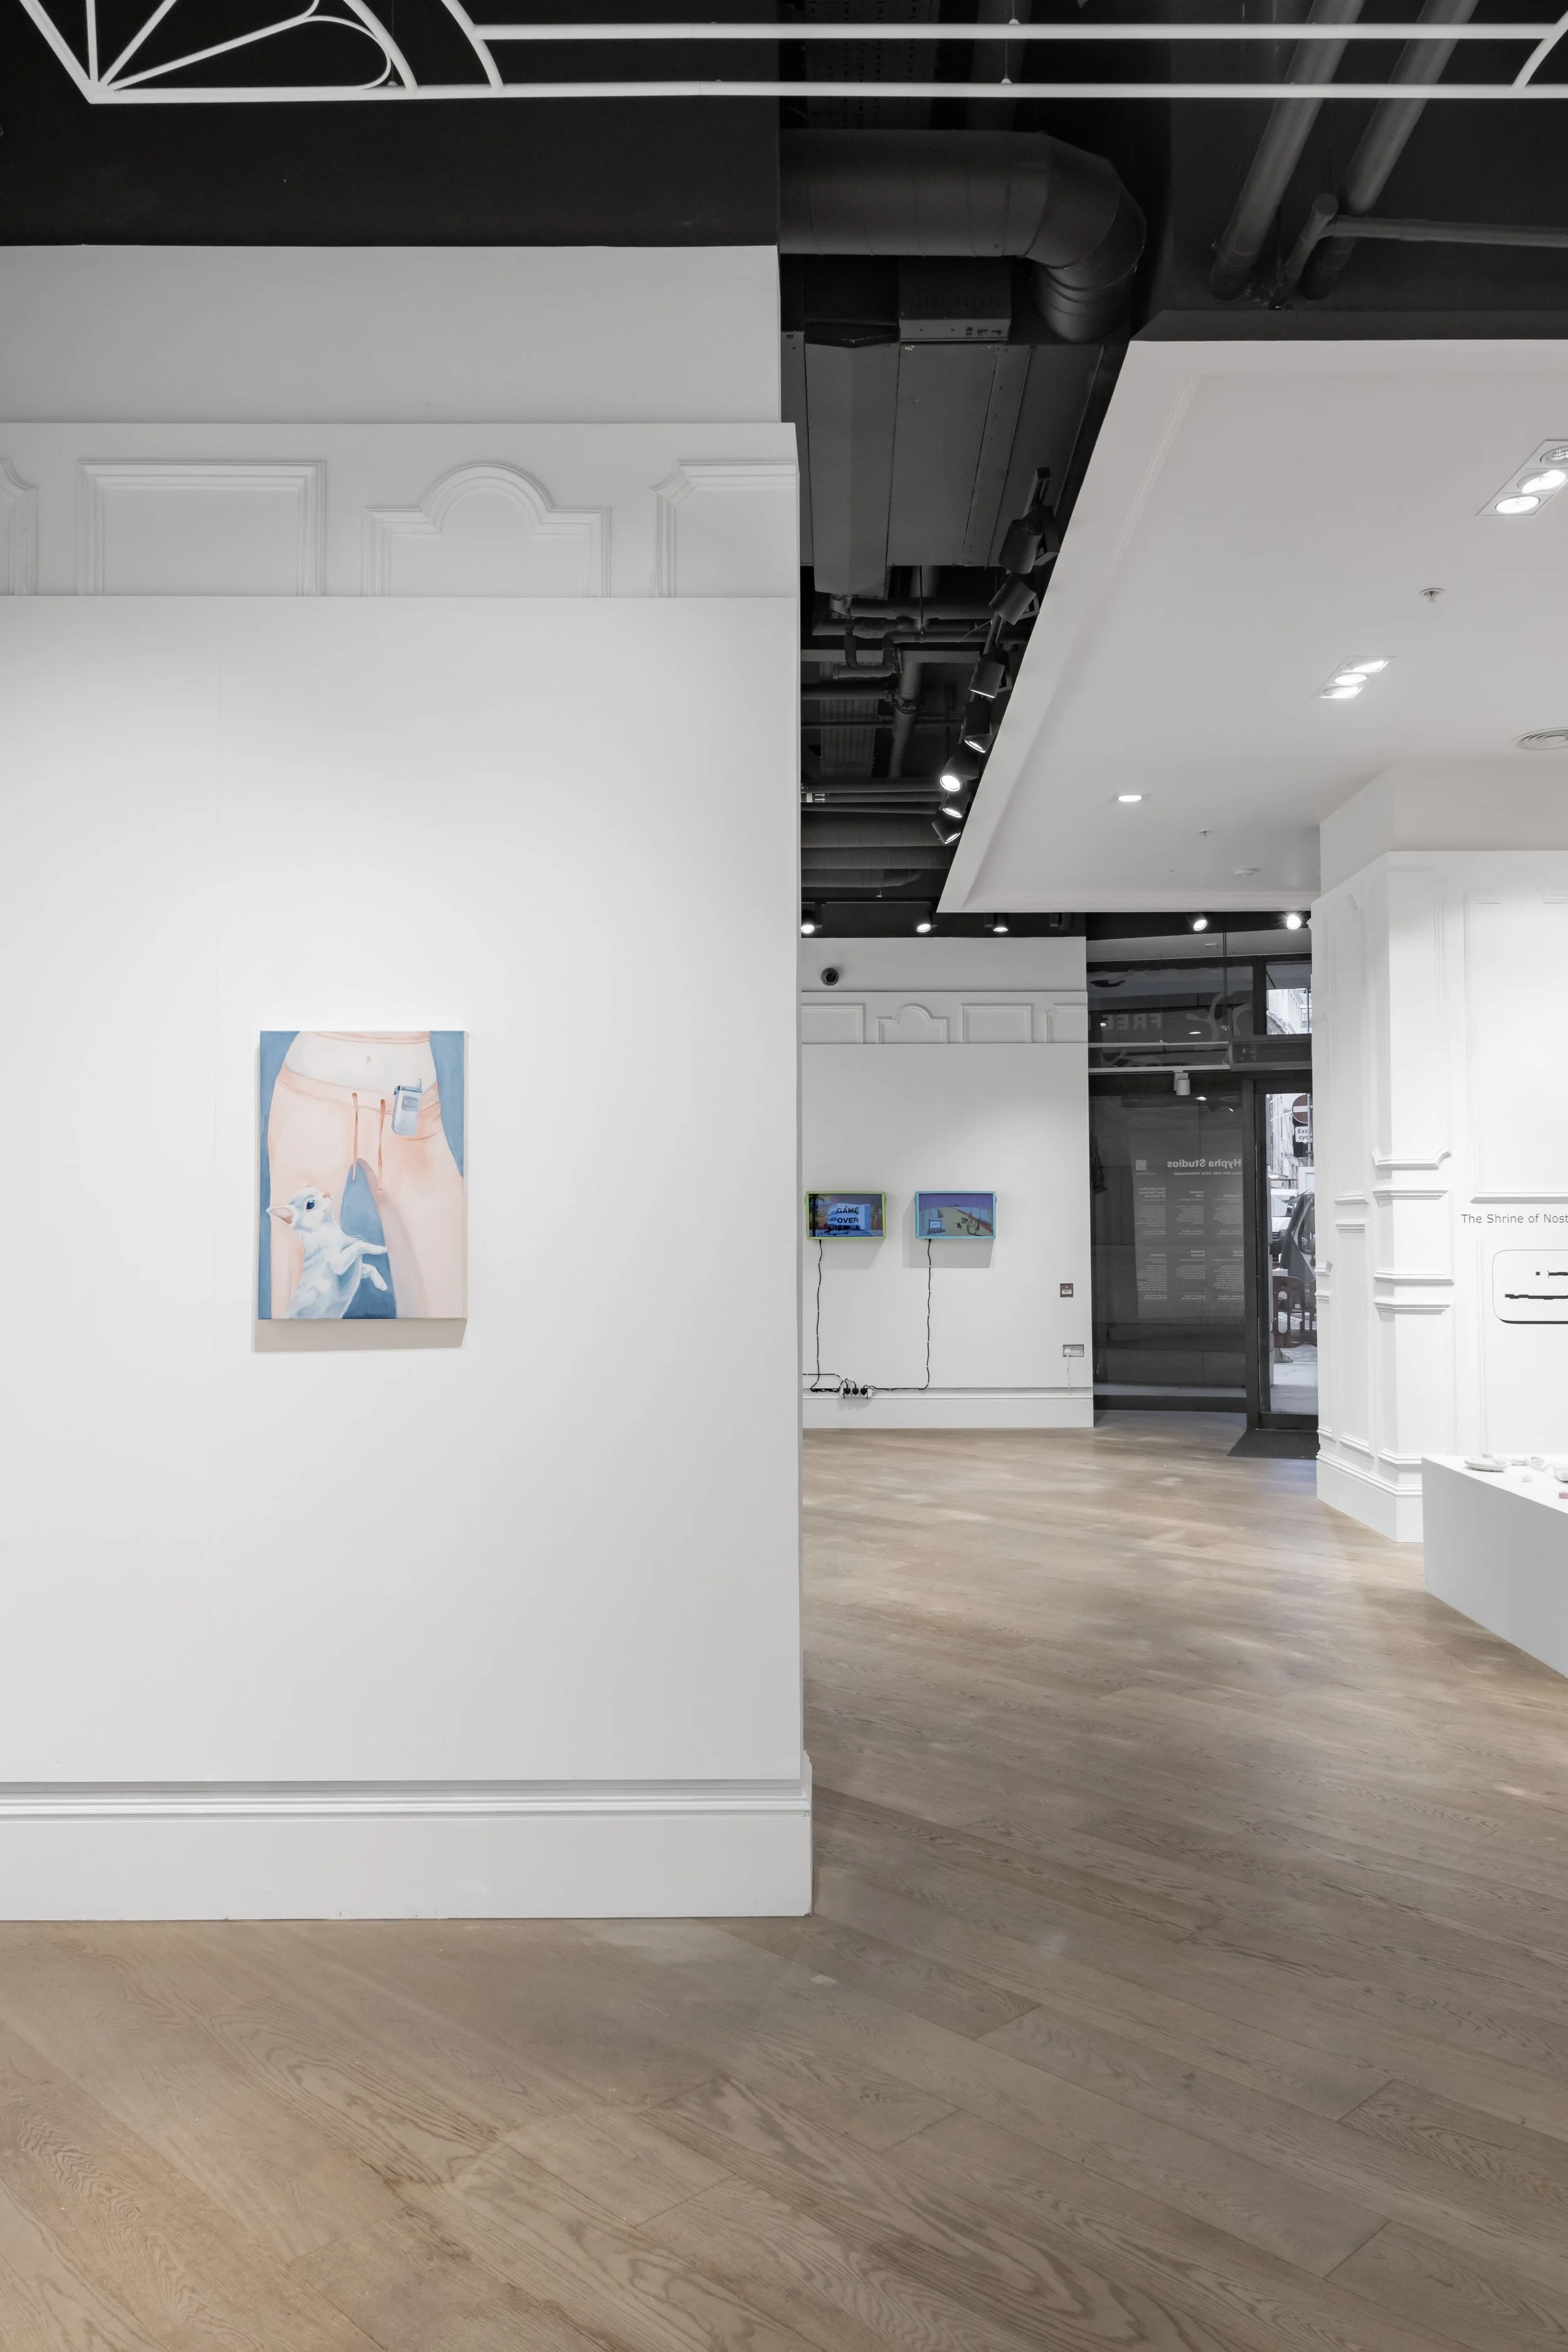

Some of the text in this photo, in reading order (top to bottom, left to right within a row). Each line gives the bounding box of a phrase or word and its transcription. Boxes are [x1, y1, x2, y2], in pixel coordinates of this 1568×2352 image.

[1461, 1214, 1482, 1223] The
[1486, 1214, 1523, 1223] Shrine
[1528, 1214, 1539, 1223] of
